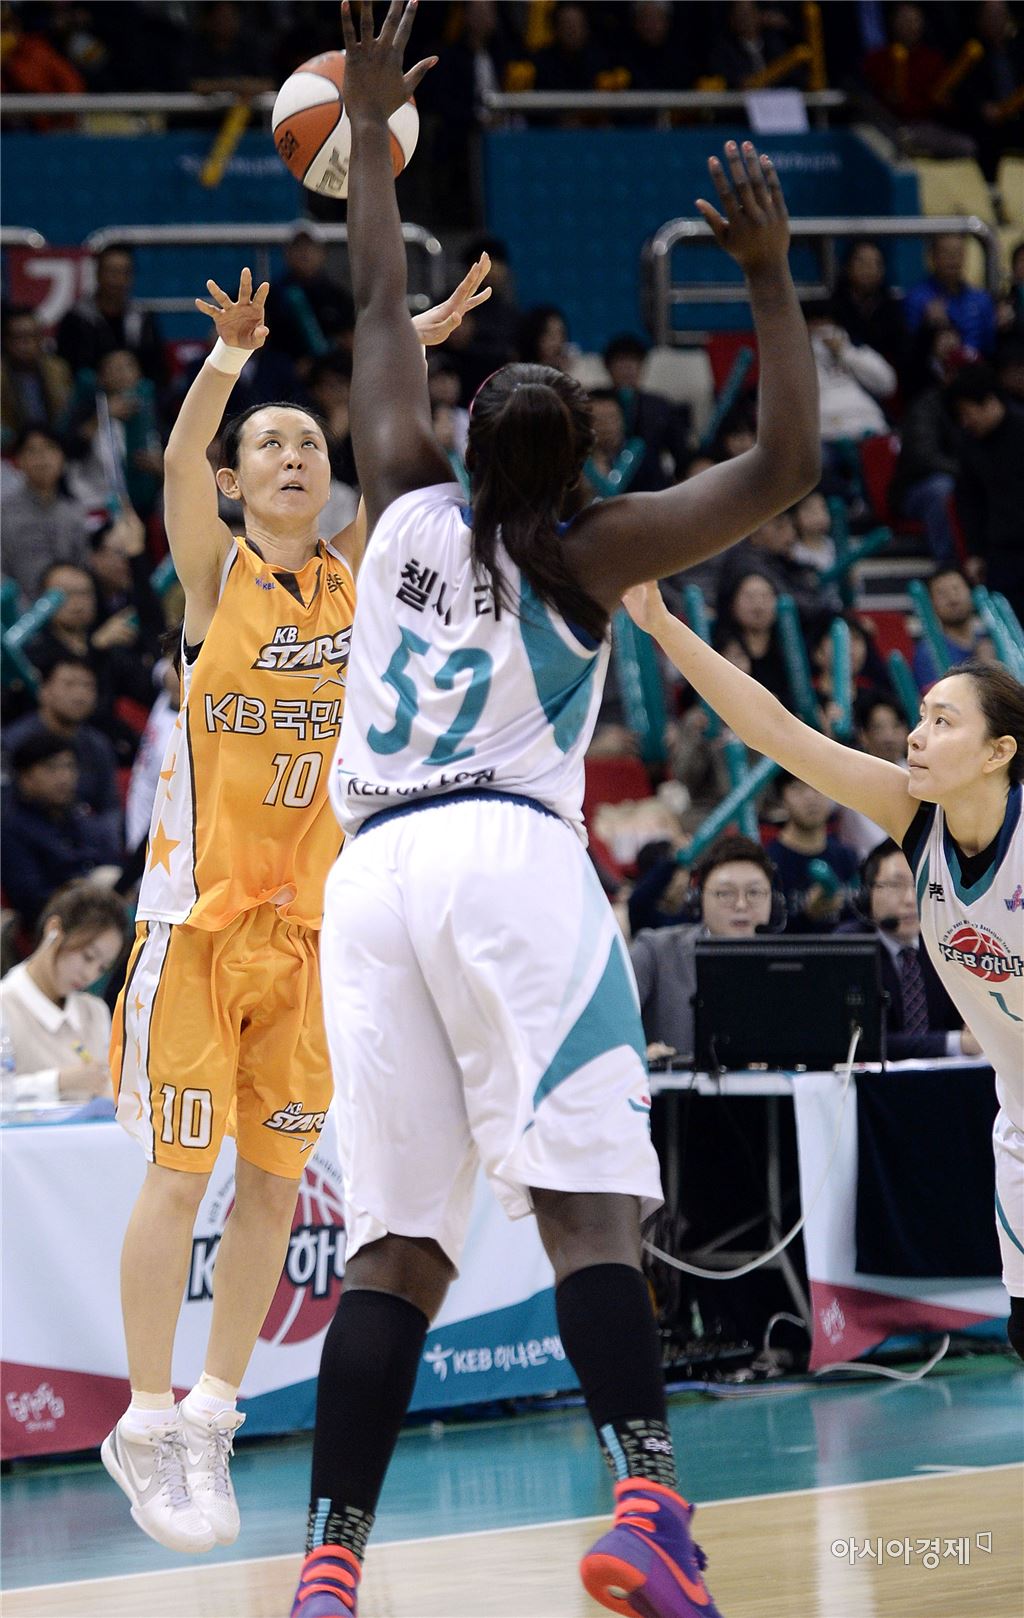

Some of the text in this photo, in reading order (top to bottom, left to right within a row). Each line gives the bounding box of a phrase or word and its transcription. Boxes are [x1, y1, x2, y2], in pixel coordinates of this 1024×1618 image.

[251, 624, 353, 671] STARS
[273, 626, 299, 645] KB
[366, 625, 494, 766] 52
[205, 693, 343, 741] KB 국민
[262, 751, 323, 808] 10
[939, 943, 977, 969] KEB
[160, 1083, 214, 1149] 10
[262, 1110, 328, 1133] STAR
[284, 1101, 303, 1115] KB
[453, 1347, 492, 1374] KEB
